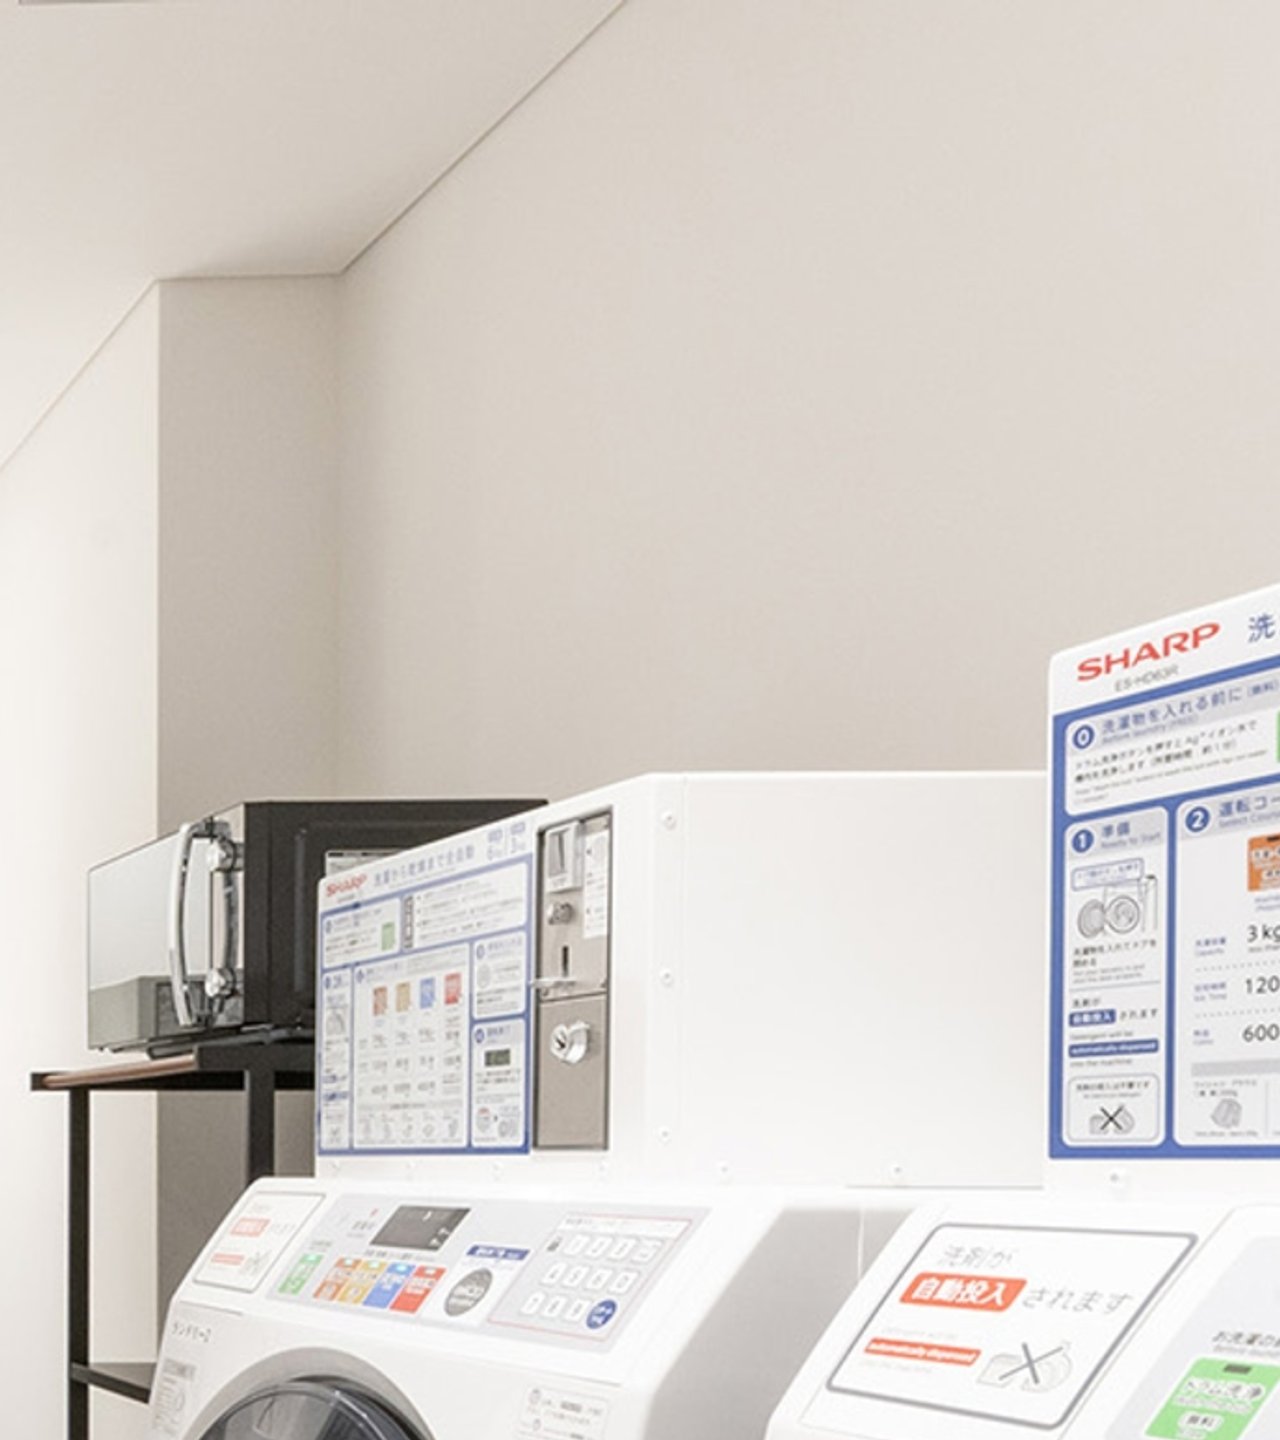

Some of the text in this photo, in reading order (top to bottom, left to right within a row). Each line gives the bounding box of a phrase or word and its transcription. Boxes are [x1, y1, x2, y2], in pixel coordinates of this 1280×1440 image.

[1077, 622, 1221, 682] SHARP
[1246, 923, 1259, 944] 3
[1245, 973, 1280, 995] 120
[1241, 1022, 1280, 1043] 600
[910, 1277, 1008, 1306] 自動投入
